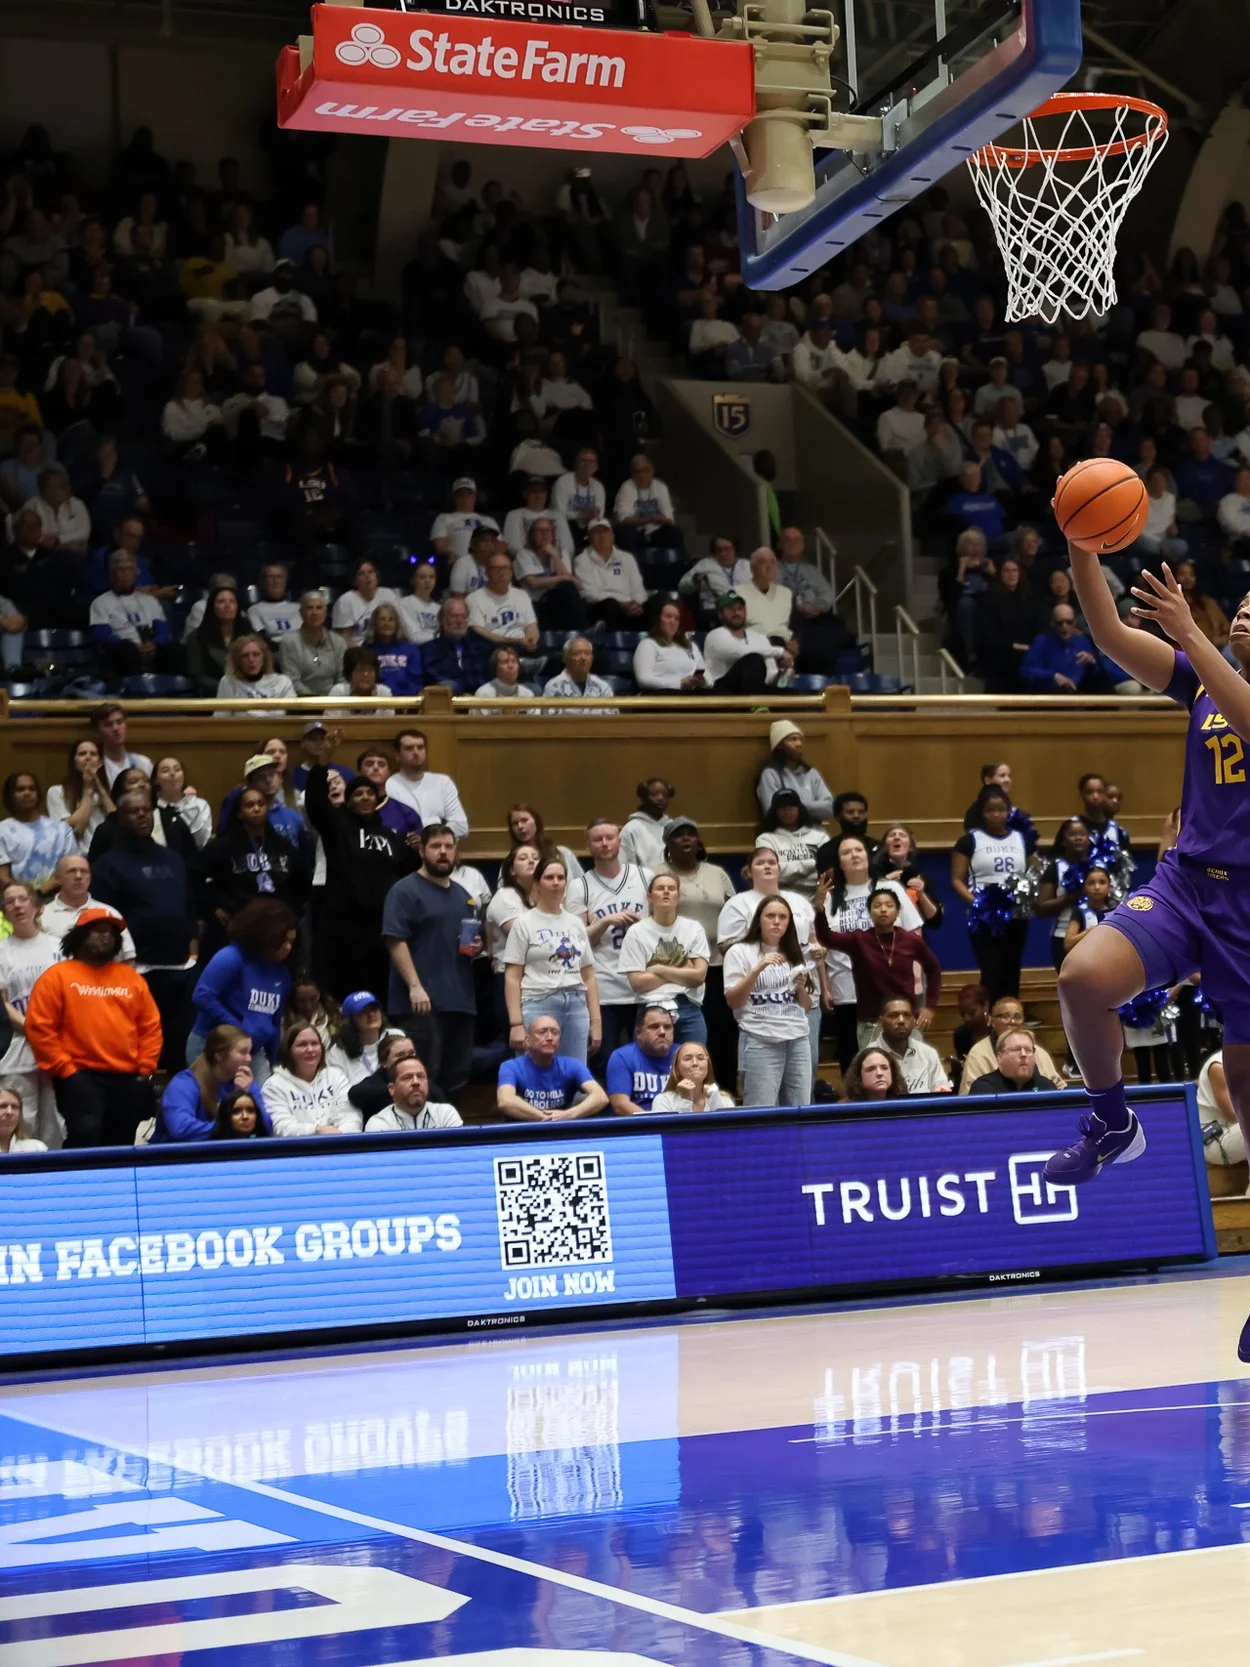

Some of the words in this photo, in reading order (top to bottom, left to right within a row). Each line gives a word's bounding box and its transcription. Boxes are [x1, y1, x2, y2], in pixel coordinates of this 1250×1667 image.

[446, 0, 604, 21] DAKTRONICS
[722, 405, 746, 429] 15
[1201, 713, 1231, 731] LS
[1204, 733, 1246, 785] 12
[994, 856, 1015, 872] 26
[802, 1171, 996, 1226] TRUIST
[55, 1225, 285, 1281] FACEBOOK
[295, 1213, 462, 1263] GROUPS
[504, 1273, 559, 1301] JOIN
[563, 1269, 616, 1296] NOW
[989, 1270, 1041, 1281] DAKTRONICS
[467, 1315, 526, 1328] DAKTRONICS
